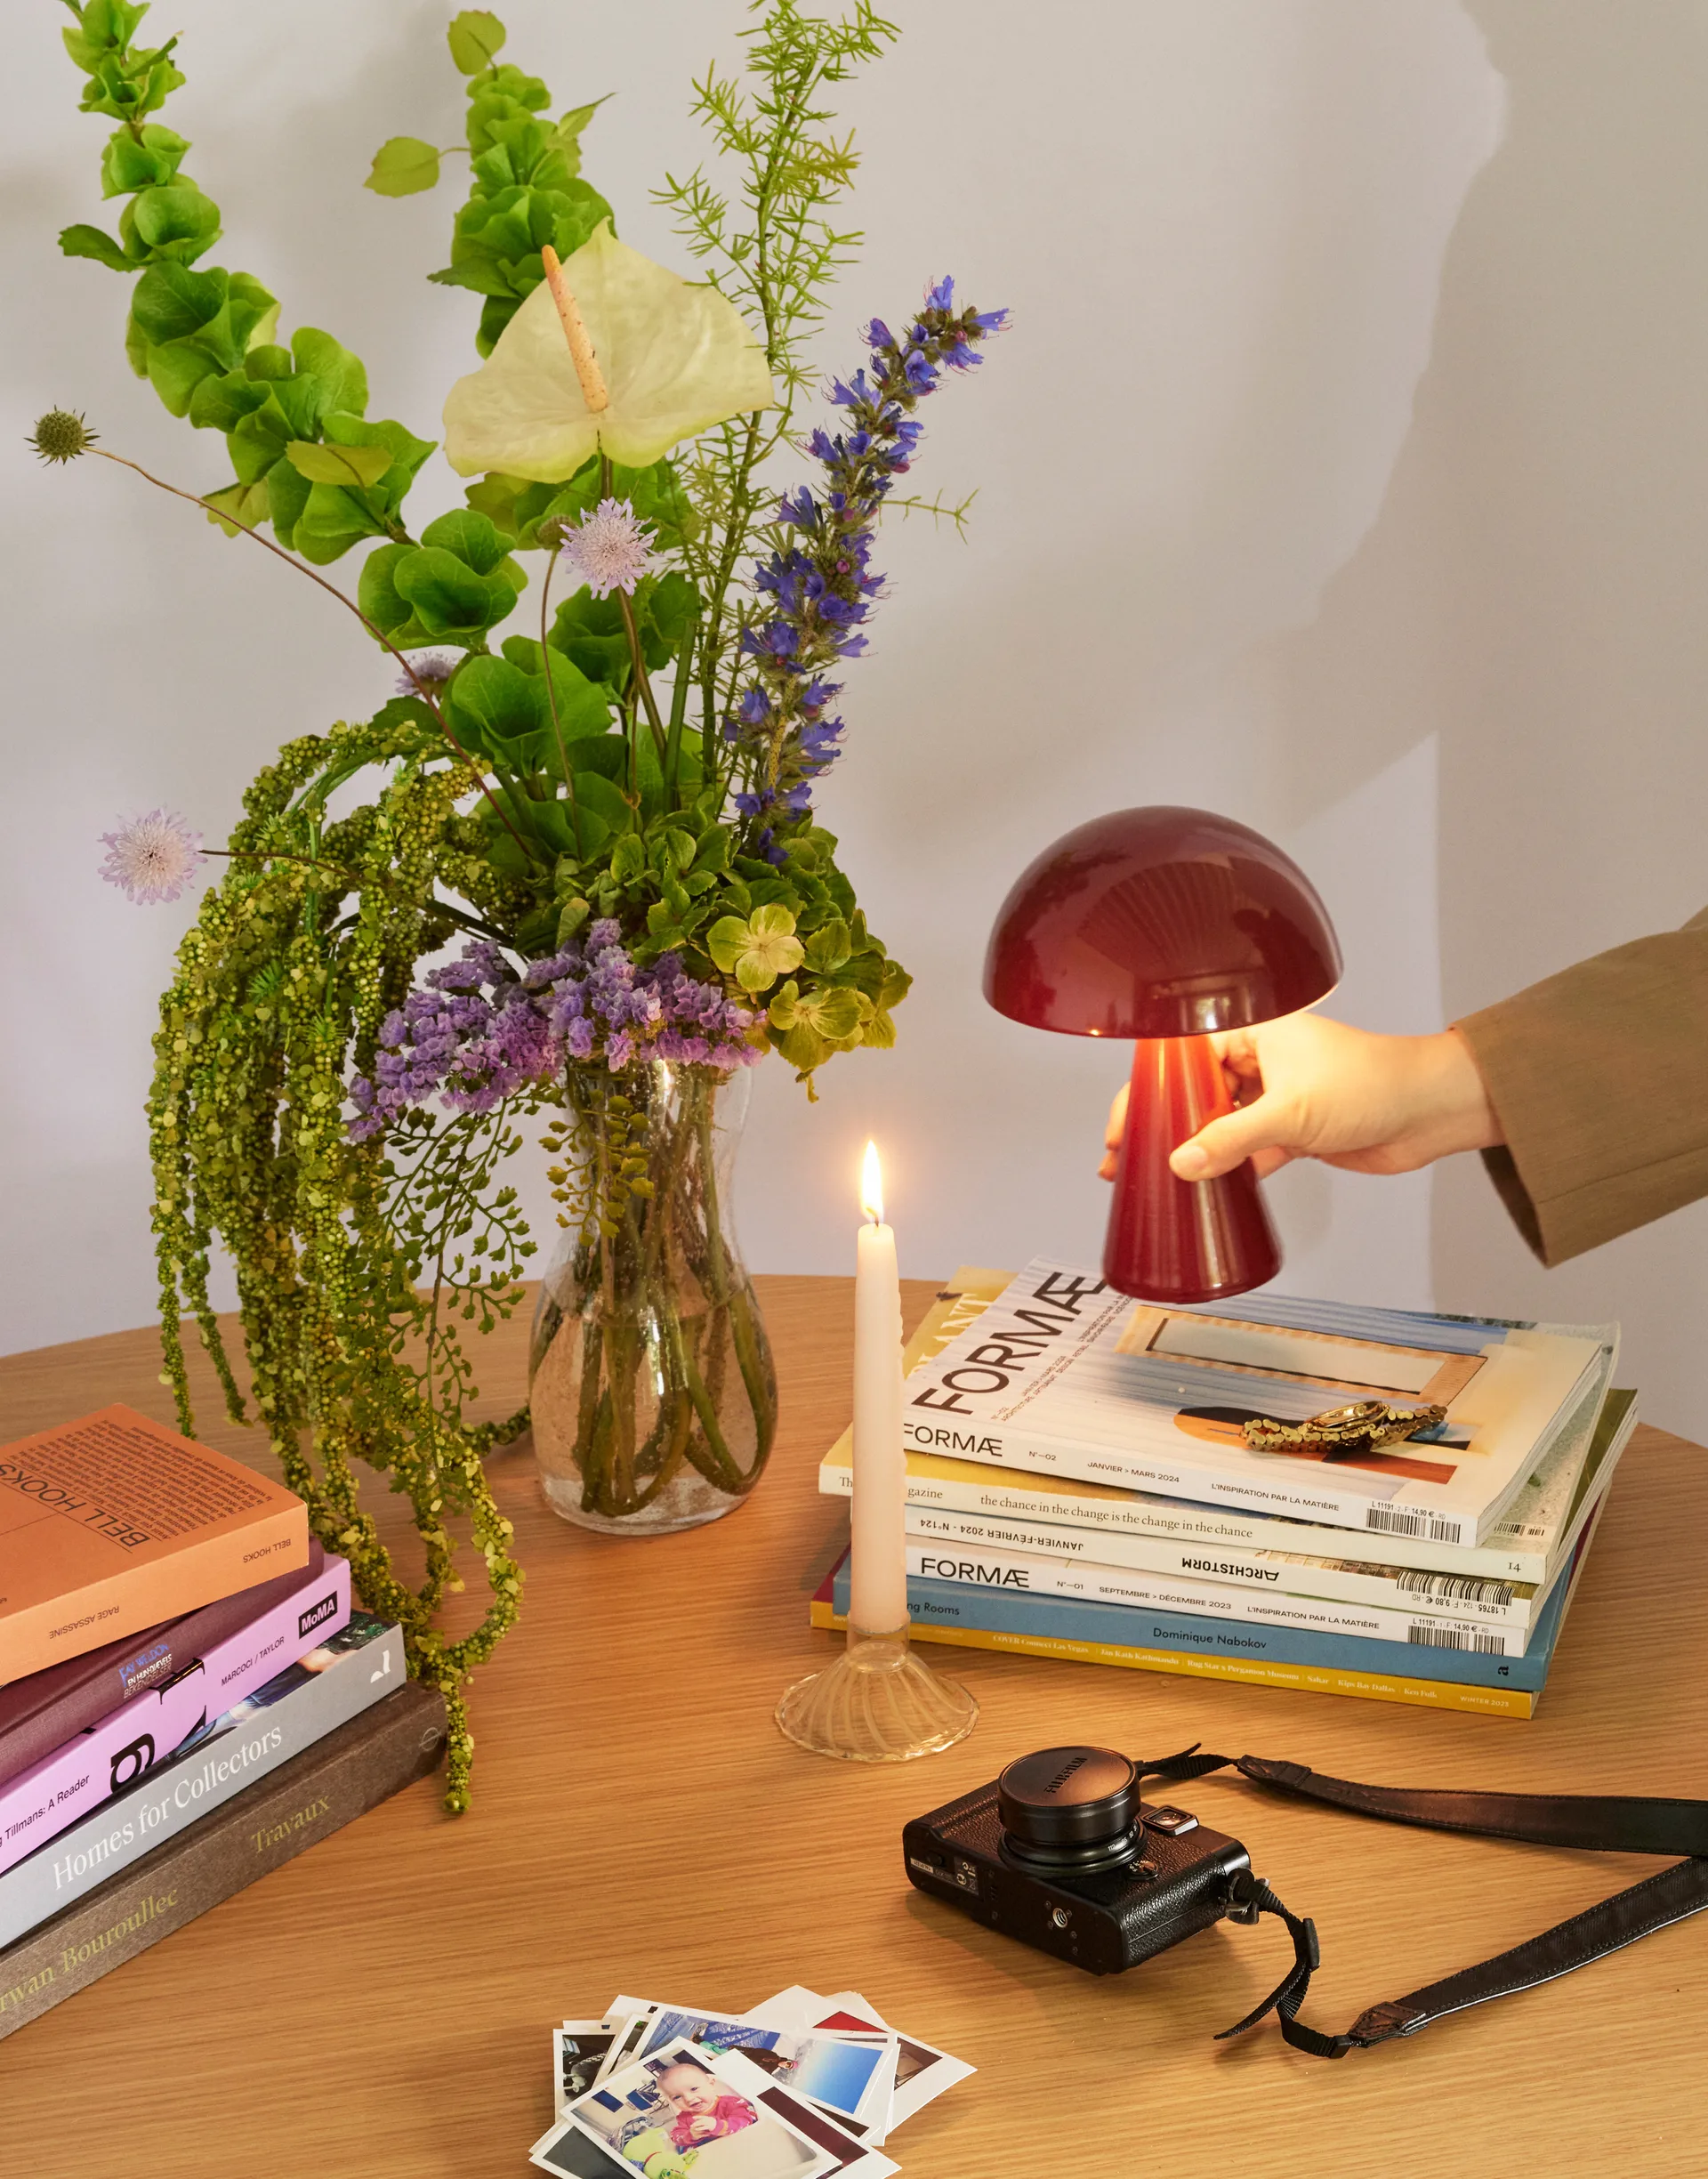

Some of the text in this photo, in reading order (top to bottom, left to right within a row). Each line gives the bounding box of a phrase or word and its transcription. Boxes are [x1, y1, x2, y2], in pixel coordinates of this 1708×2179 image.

[911, 1271, 1108, 1415] FORMÆ
[904, 1423, 1003, 1457] FORMÆ
[1087, 1461, 1123, 1473] JANVIER
[1131, 1469, 1156, 1479] MARS
[1157, 1473, 1180, 1483] 2024
[1212, 1482, 1269, 1499] L'INSPIRATION
[1271, 1494, 1287, 1503] PAR
[1289, 1496, 1301, 1505] LA
[1302, 1499, 1339, 1512] MATIÈRE
[0, 1464, 150, 1547] BELL HOOKS
[1377, 1502, 1394, 1510] 11191
[839, 1476, 1521, 1573] Th gazine the chance in the change is the change in the chance 14
[960, 1525, 984, 1536] 2024
[987, 1529, 1084, 1551] JANVIER-FÉVRIER
[243, 1538, 292, 1563] BELL HOOKS
[1182, 1558, 1279, 1582] ARCHISTORM
[921, 1557, 1029, 1588] FORMÆ
[1100, 1586, 1150, 1599] SEPTEMBRE
[1159, 1592, 1206, 1607] DÉCEMBRE
[1209, 1601, 1231, 1610] 2023
[1247, 1605, 1307, 1620] L'INSPIRATION
[1309, 1613, 1326, 1622] PAR
[1328, 1616, 1340, 1624] LA
[1342, 1617, 1380, 1630] MATIÈRE
[924, 1603, 960, 1615] Rooms
[1478, 1603, 1499, 1614] 18765
[49, 1605, 120, 1639] RAGE ASSASSINE
[301, 1599, 335, 1633] MoMA
[1419, 1618, 1435, 1626] 11191
[1153, 1627, 1267, 1650] Dominique Nabokov
[221, 1658, 253, 1687] MARCOCI
[259, 1635, 285, 1659] TAYLOR
[1460, 1695, 1490, 1706] WINTER
[1043, 1757, 1088, 1794] FUJIFILM
[4, 1774, 90, 1841] Tillmans: A Reader
[53, 1823, 134, 1891] Homes
[138, 1797, 170, 1836] for
[174, 1726, 282, 1809] Collectors
[251, 1795, 331, 1855] Travaux
[0, 1886, 178, 2014] rwan Bouroullec
